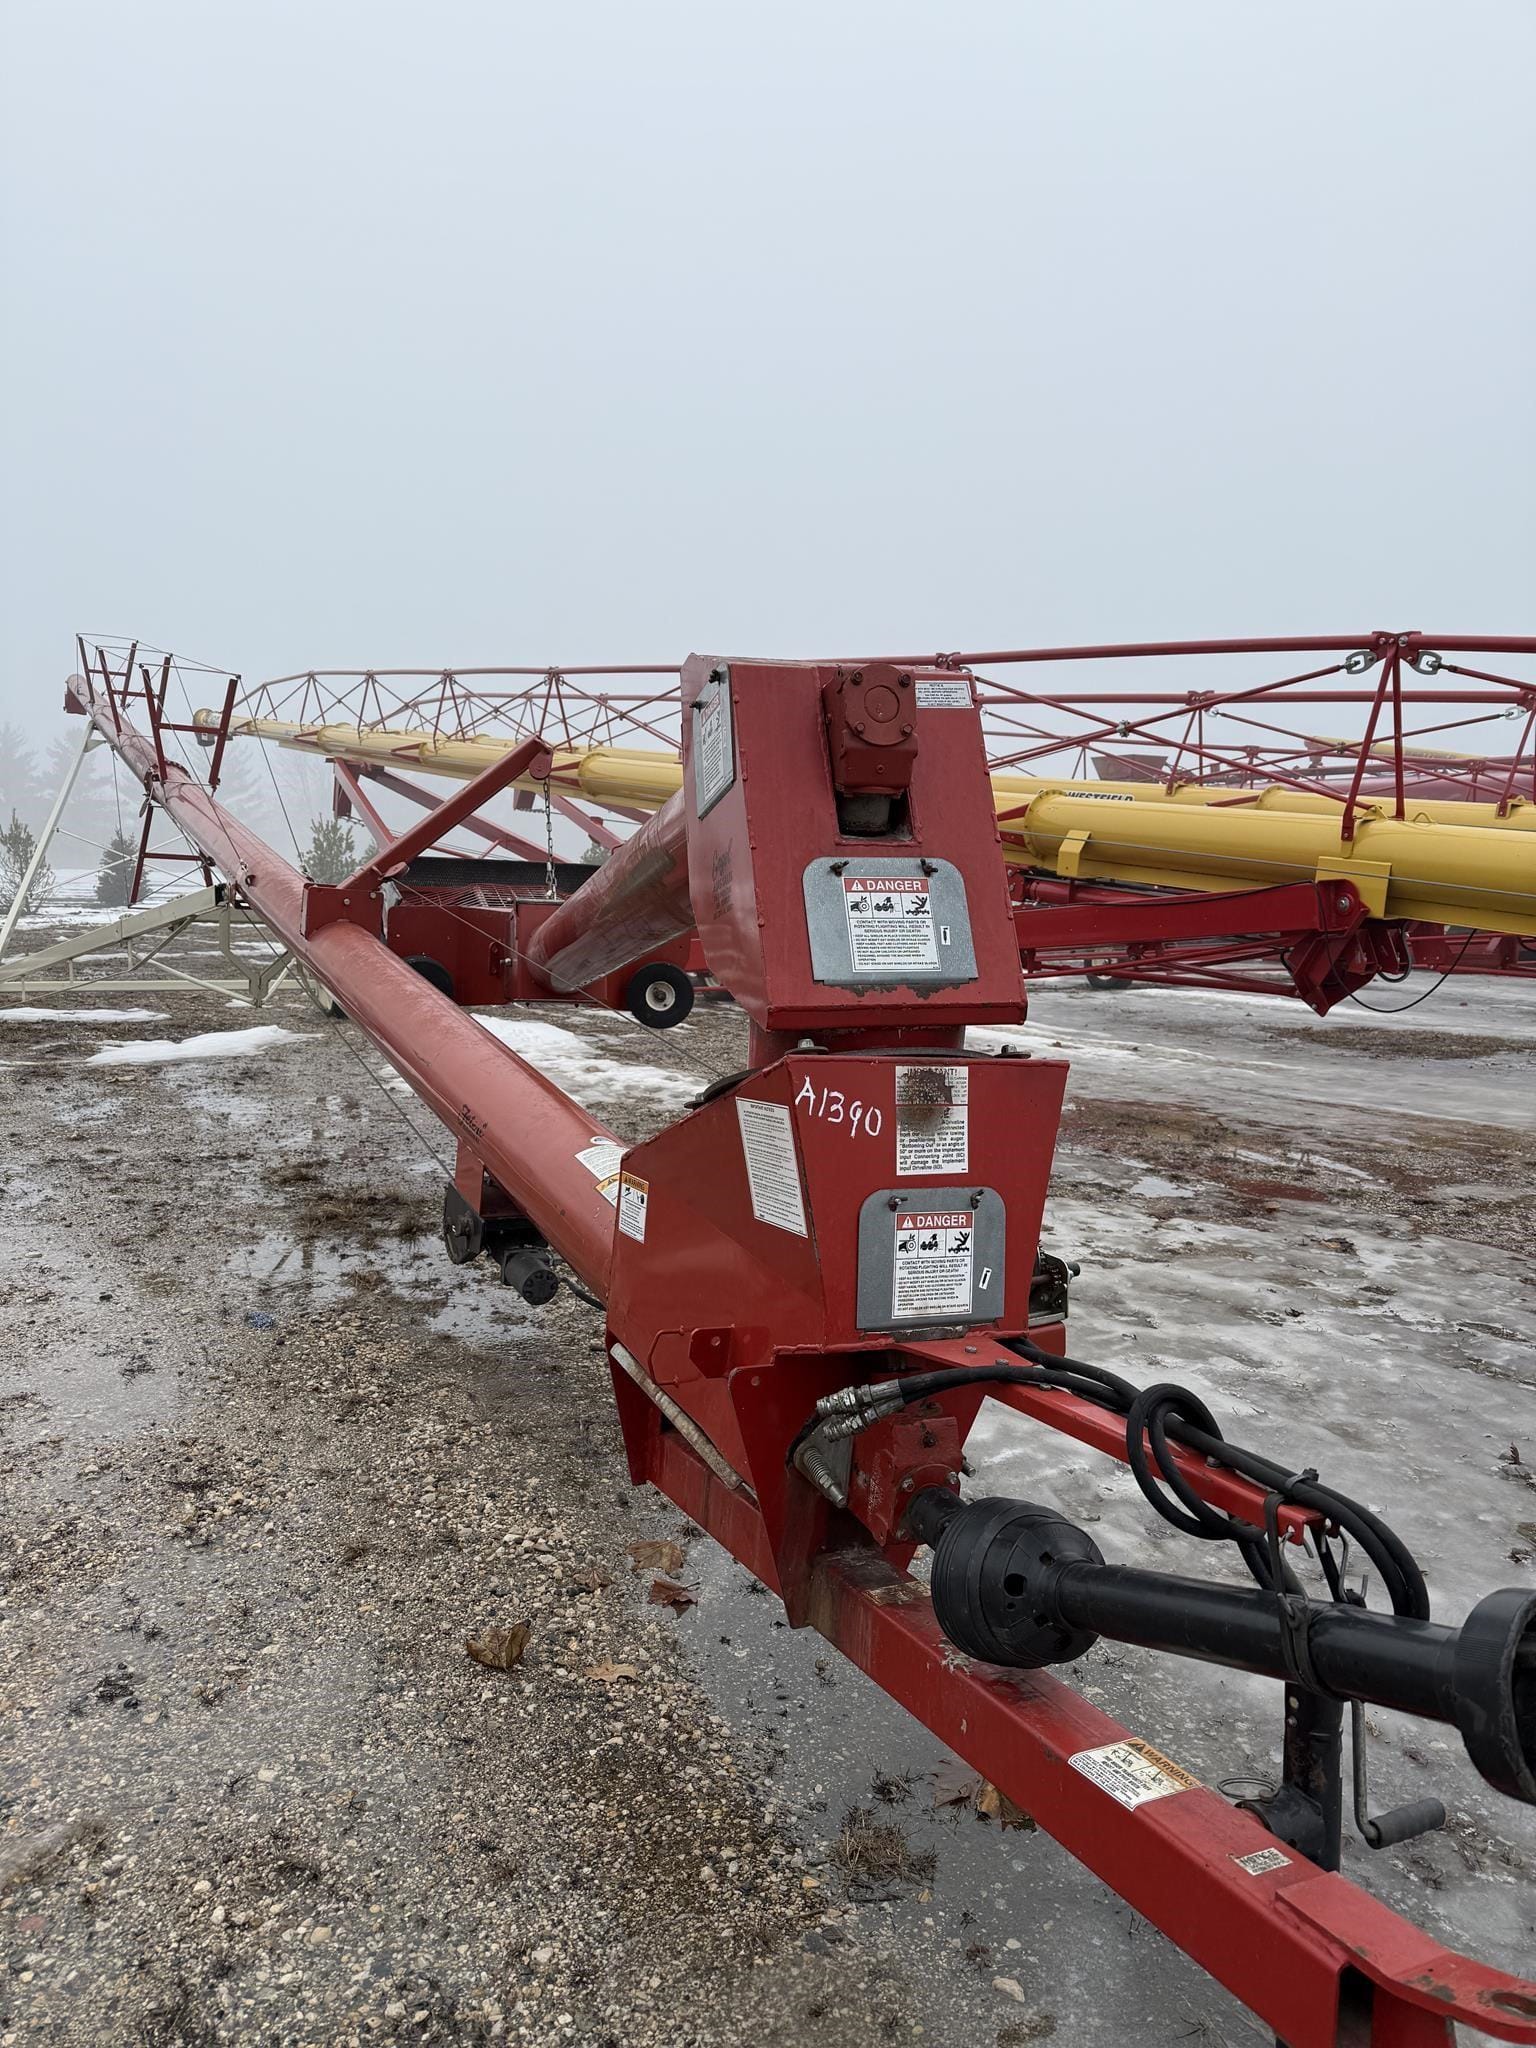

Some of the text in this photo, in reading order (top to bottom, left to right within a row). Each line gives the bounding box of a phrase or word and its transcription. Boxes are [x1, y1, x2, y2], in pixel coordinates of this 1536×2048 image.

[866, 880, 922, 891] DANGER
[795, 1076, 881, 1138] A1390
[917, 1215, 967, 1227] DANGER
[1144, 1749, 1194, 1786] WARNING
[1240, 1850, 1274, 1866] NOTICE
